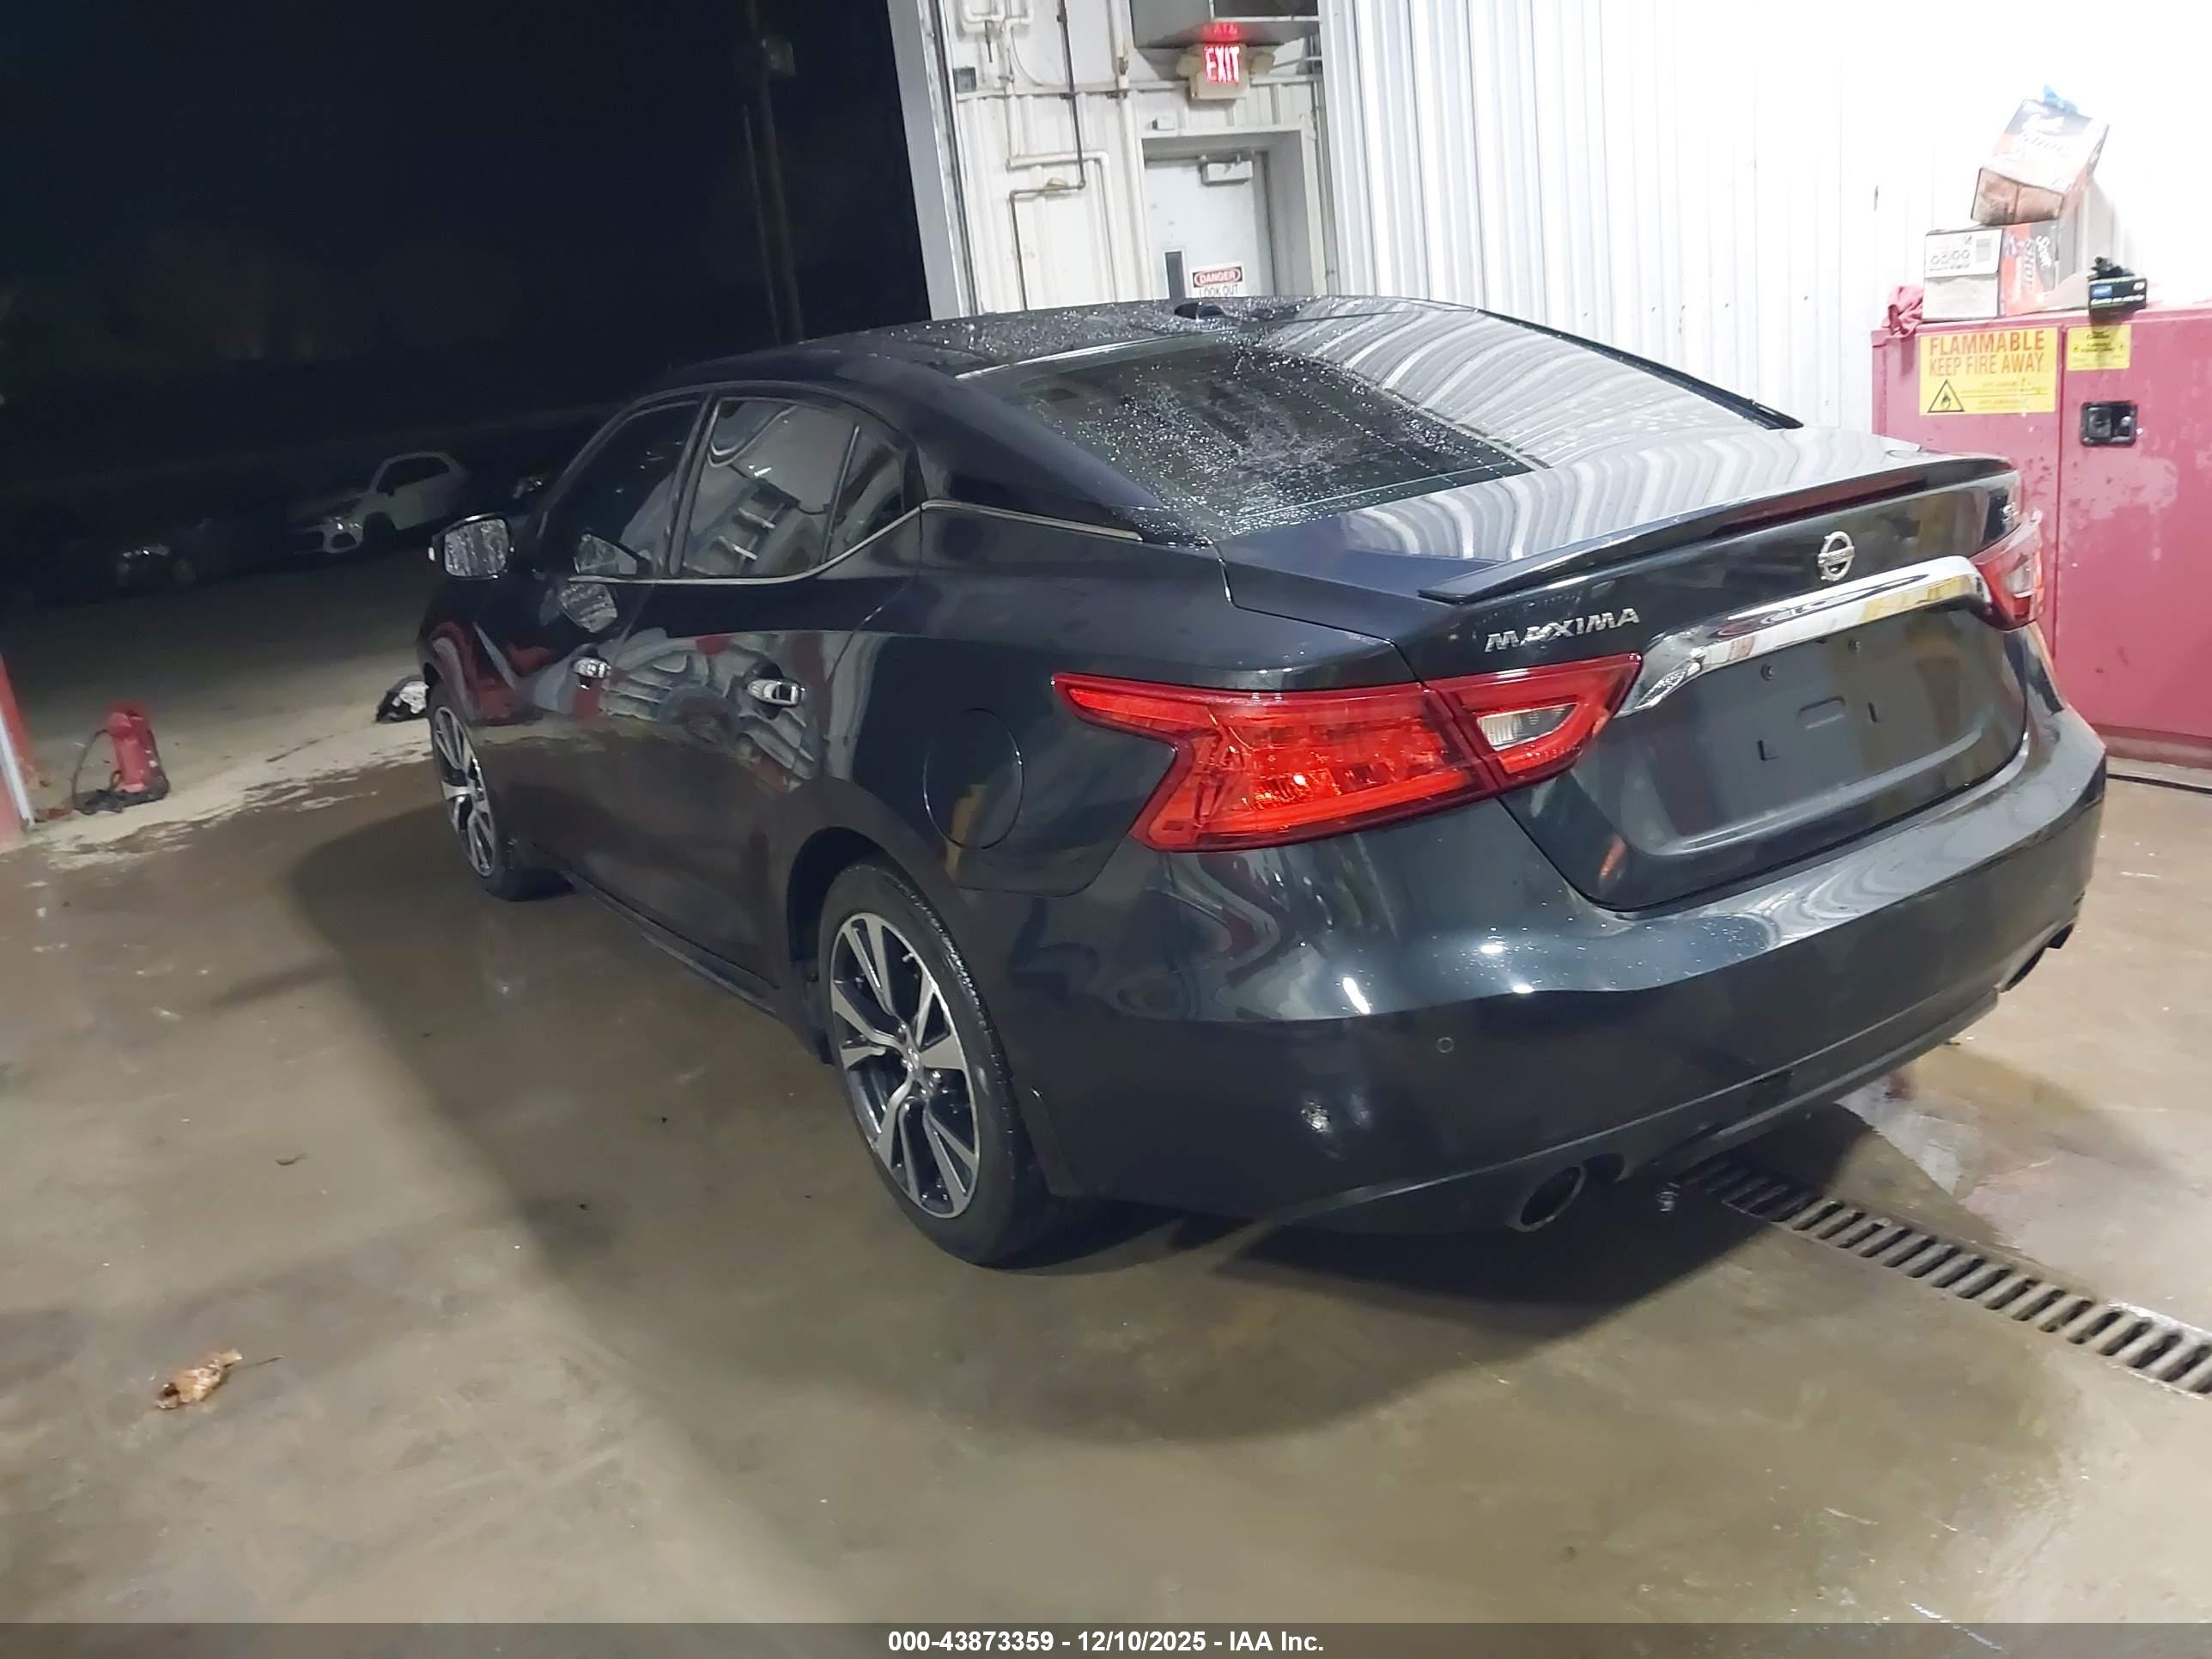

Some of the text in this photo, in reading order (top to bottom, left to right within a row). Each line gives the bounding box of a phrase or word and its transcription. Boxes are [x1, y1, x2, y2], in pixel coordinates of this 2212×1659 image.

[1204, 46, 1239, 82] EXIT
[1200, 270, 1236, 283] DANGER
[1930, 330, 2045, 356] FLAMMABLE
[1929, 352, 2045, 377] KEEP FIRE AWAY
[1484, 608, 1641, 653] MAXIMA
